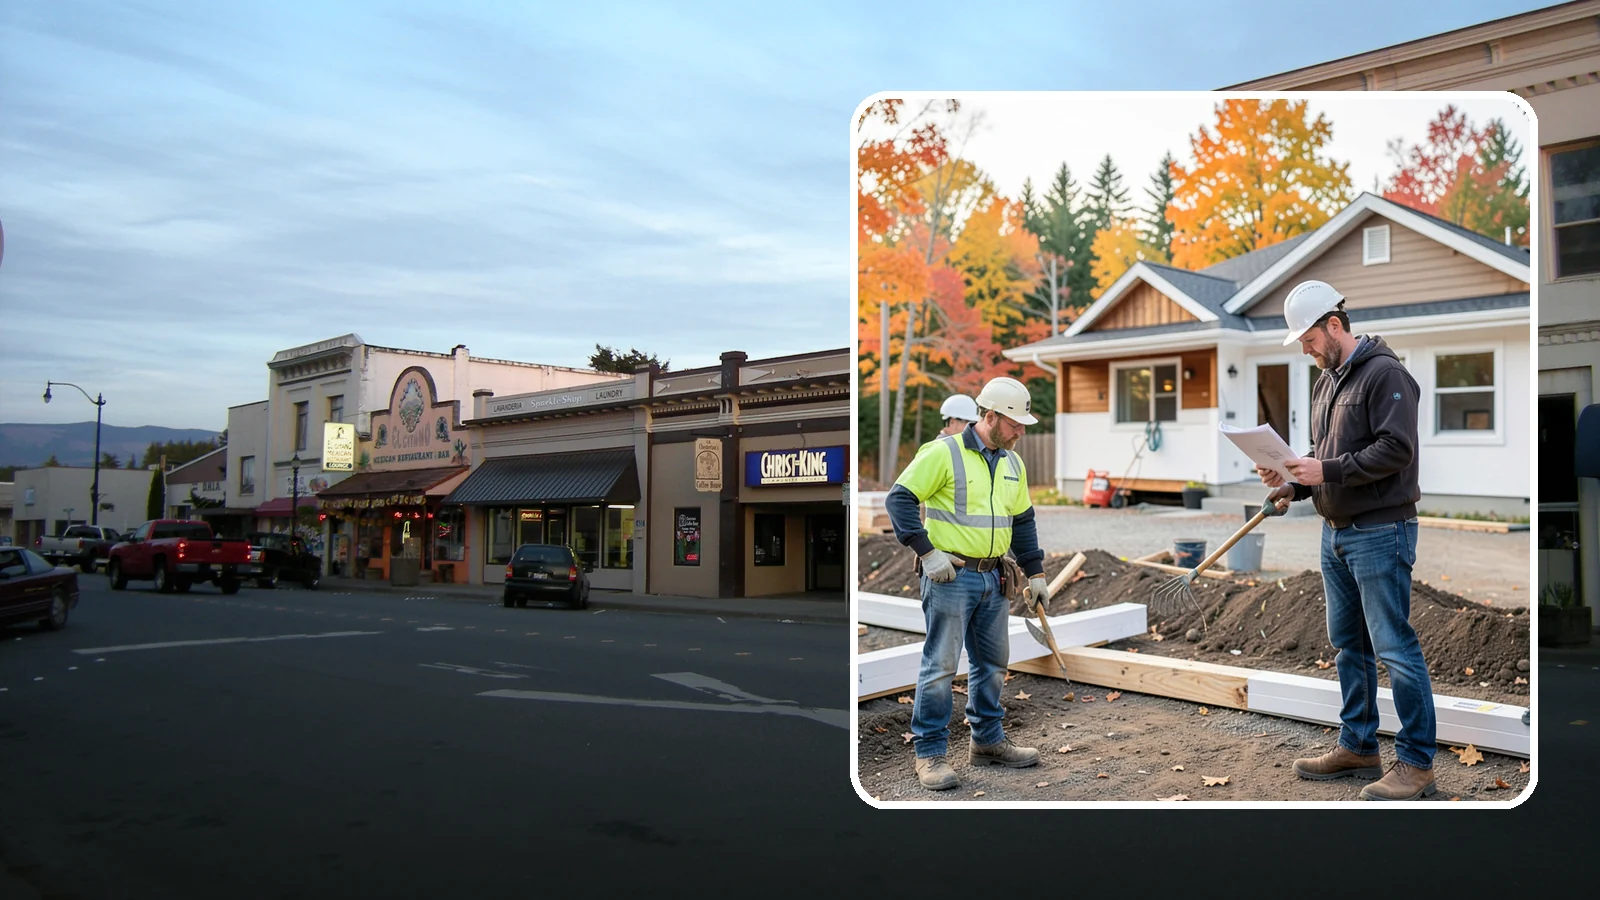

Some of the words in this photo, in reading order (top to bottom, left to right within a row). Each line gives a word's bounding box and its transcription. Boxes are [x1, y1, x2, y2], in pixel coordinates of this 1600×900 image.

[531, 395, 560, 408] Sparkle
[561, 394, 582, 405] Shop
[595, 389, 624, 400] LAUNDRY
[493, 402, 522, 412] LAVANDERIA
[373, 455, 396, 464] MEXICAN
[397, 451, 433, 462] RESTAURANT
[438, 450, 449, 458] BAR
[761, 452, 797, 478] CHRIST
[799, 450, 827, 476] KING
